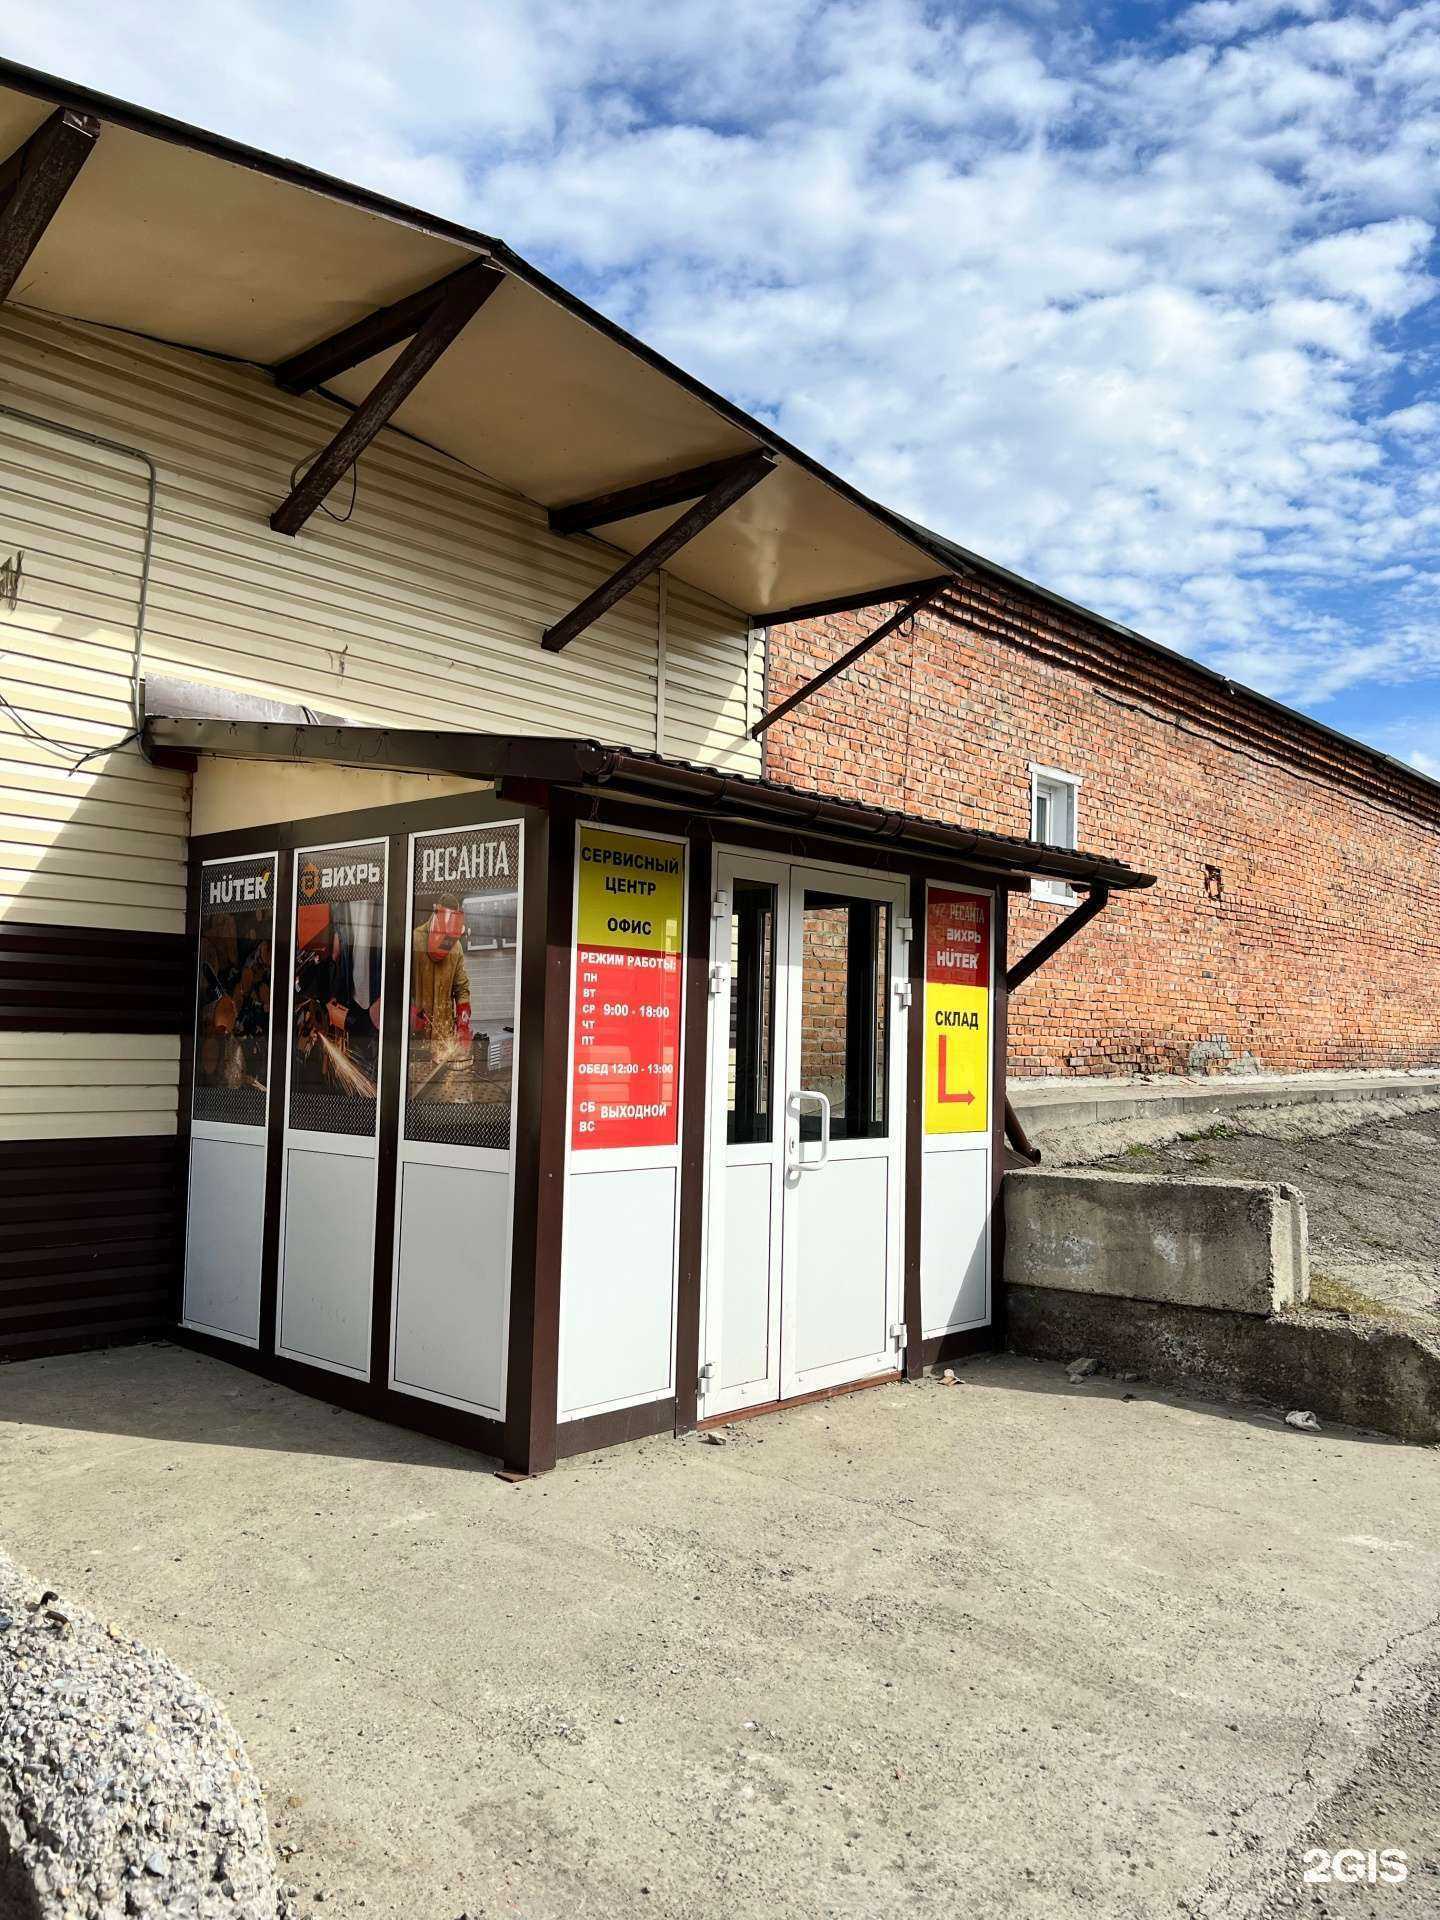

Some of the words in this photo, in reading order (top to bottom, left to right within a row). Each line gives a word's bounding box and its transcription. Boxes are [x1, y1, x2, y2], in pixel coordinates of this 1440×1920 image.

[422, 841, 509, 883] РЕСАНТА
[581, 847, 679, 874] СЕРВИСНЫЙ
[321, 863, 381, 889] ВИХРЬ
[209, 874, 267, 904] HÜTER
[605, 876, 656, 895] ЦЕНТР
[950, 903, 985, 924] РЕСАНТА
[607, 917, 652, 935] ОФИС
[946, 928, 982, 944] ВИХРЬ
[580, 951, 625, 966] РЕЖИМ
[936, 948, 979, 969] HÜTER
[583, 972, 598, 983] ПН
[583, 988, 597, 998] ВТ
[582, 1003, 596, 1014] СР
[603, 1003, 629, 1017] 9:00
[639, 1005, 670, 1018] 18:00
[582, 1019, 596, 1030] ЧТ
[935, 1010, 979, 1029] СКЛАД
[581, 1035, 595, 1046] ПТ
[578, 1063, 609, 1075] ОБЕД
[612, 1063, 639, 1074] 12:00
[647, 1063, 674, 1075] 13:00
[579, 1101, 596, 1113] СБ
[579, 1120, 596, 1132] ВС
